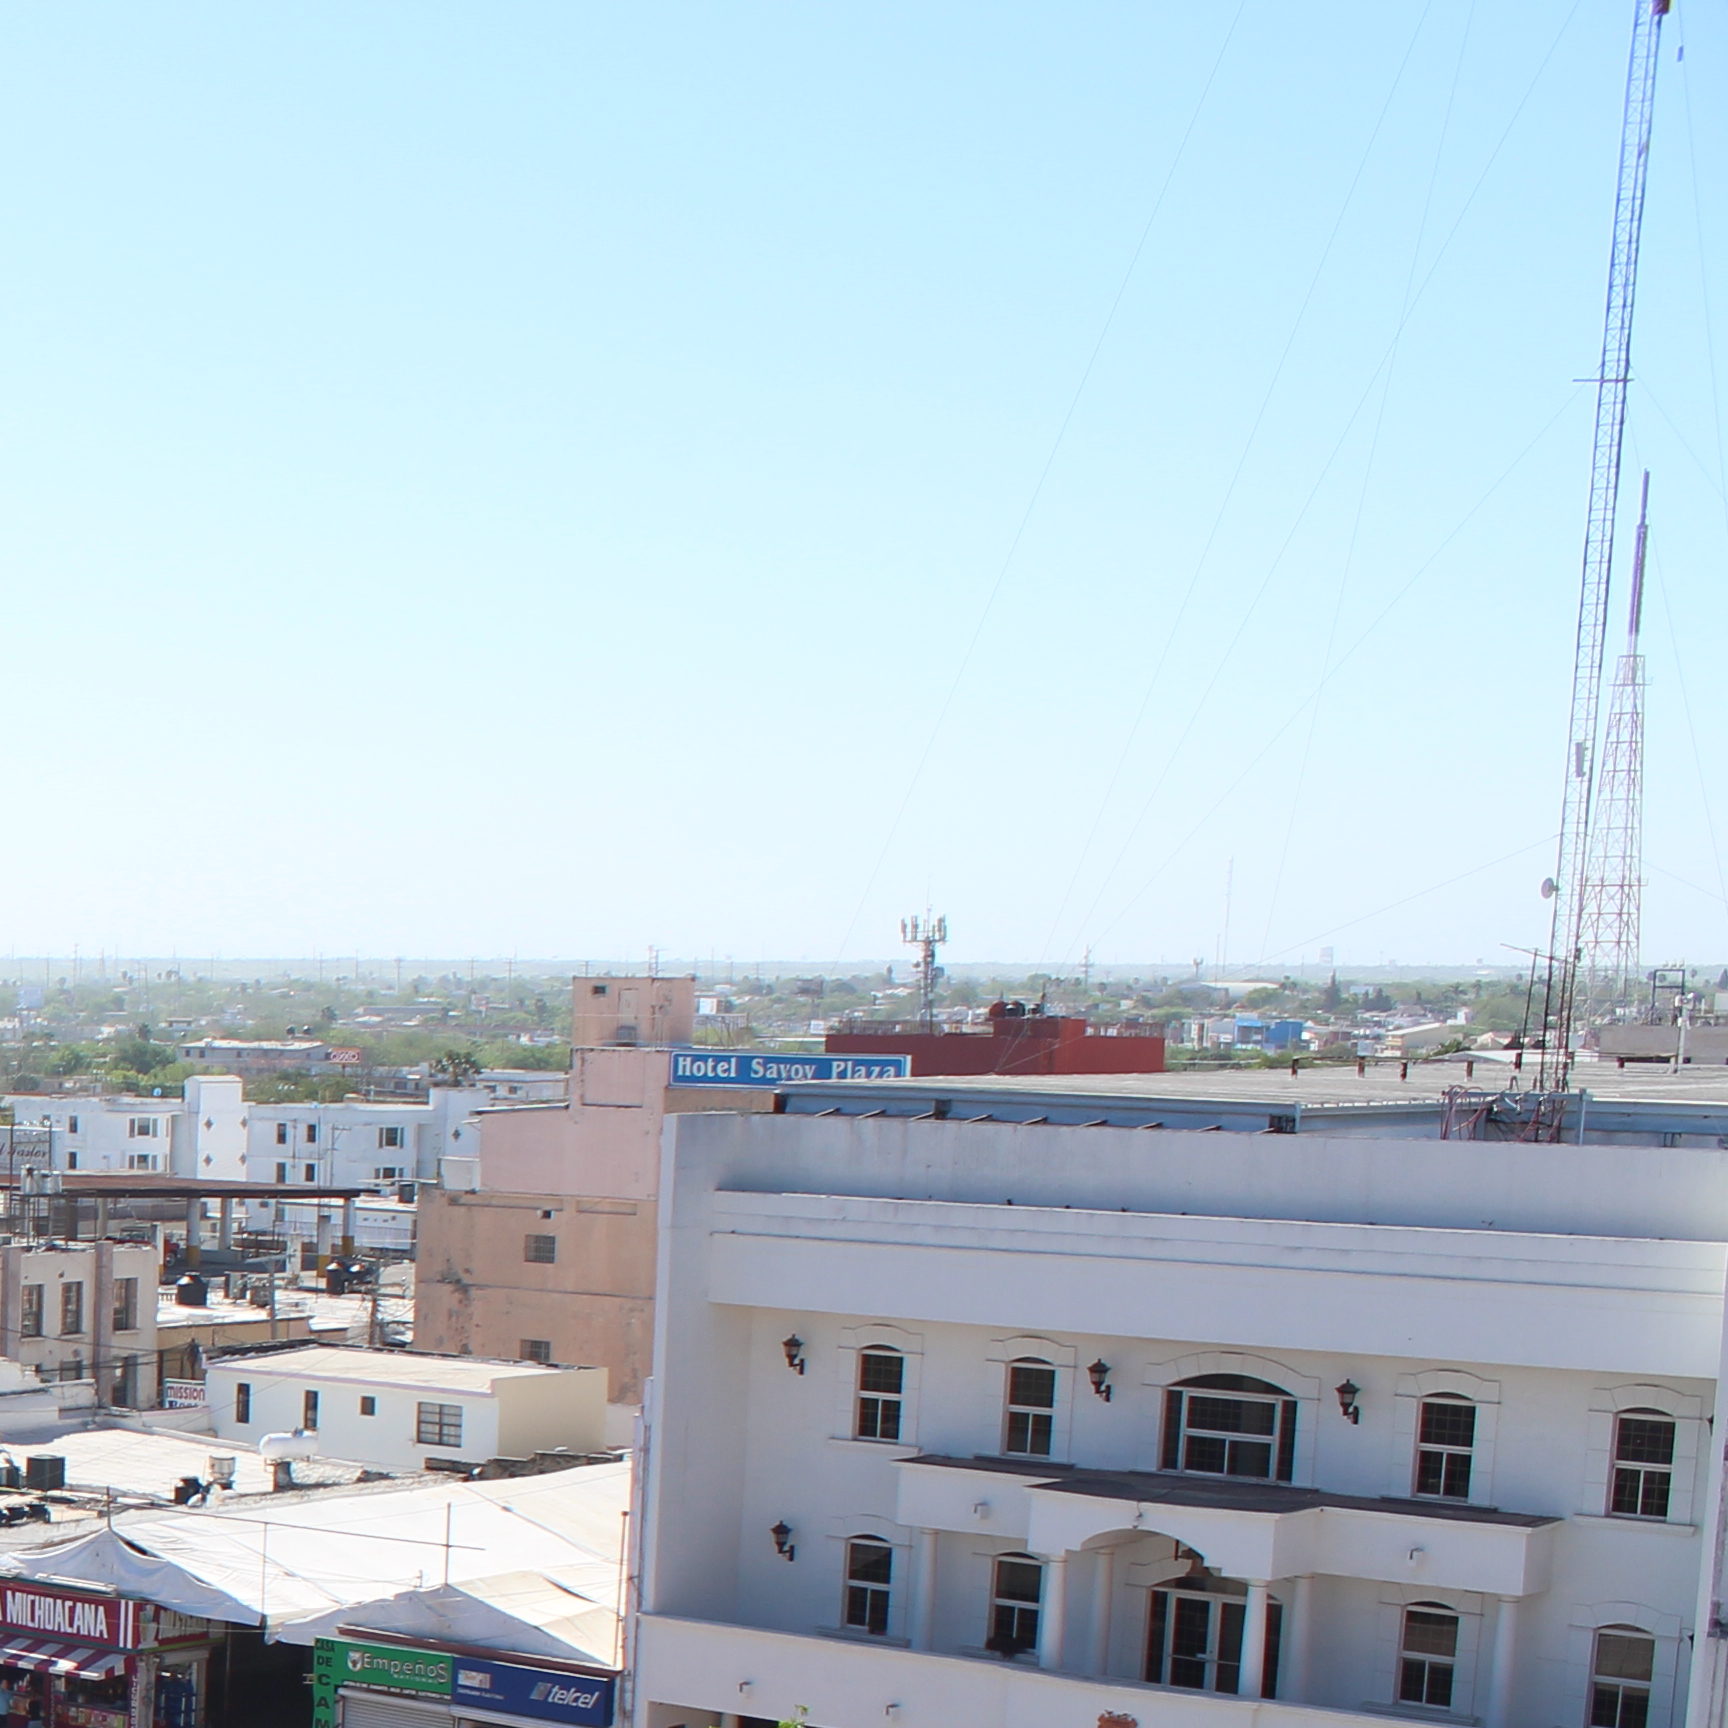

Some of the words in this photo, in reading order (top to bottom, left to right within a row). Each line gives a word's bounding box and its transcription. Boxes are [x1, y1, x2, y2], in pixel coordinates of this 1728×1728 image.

[676, 1056, 737, 1078] Hotel
[750, 1058, 817, 1080] Savoy
[831, 1060, 896, 1080] Plaza
[6, 1590, 109, 1639] MICHOACANA
[316, 1655, 333, 1667] DE
[547, 1684, 600, 1708] telcel
